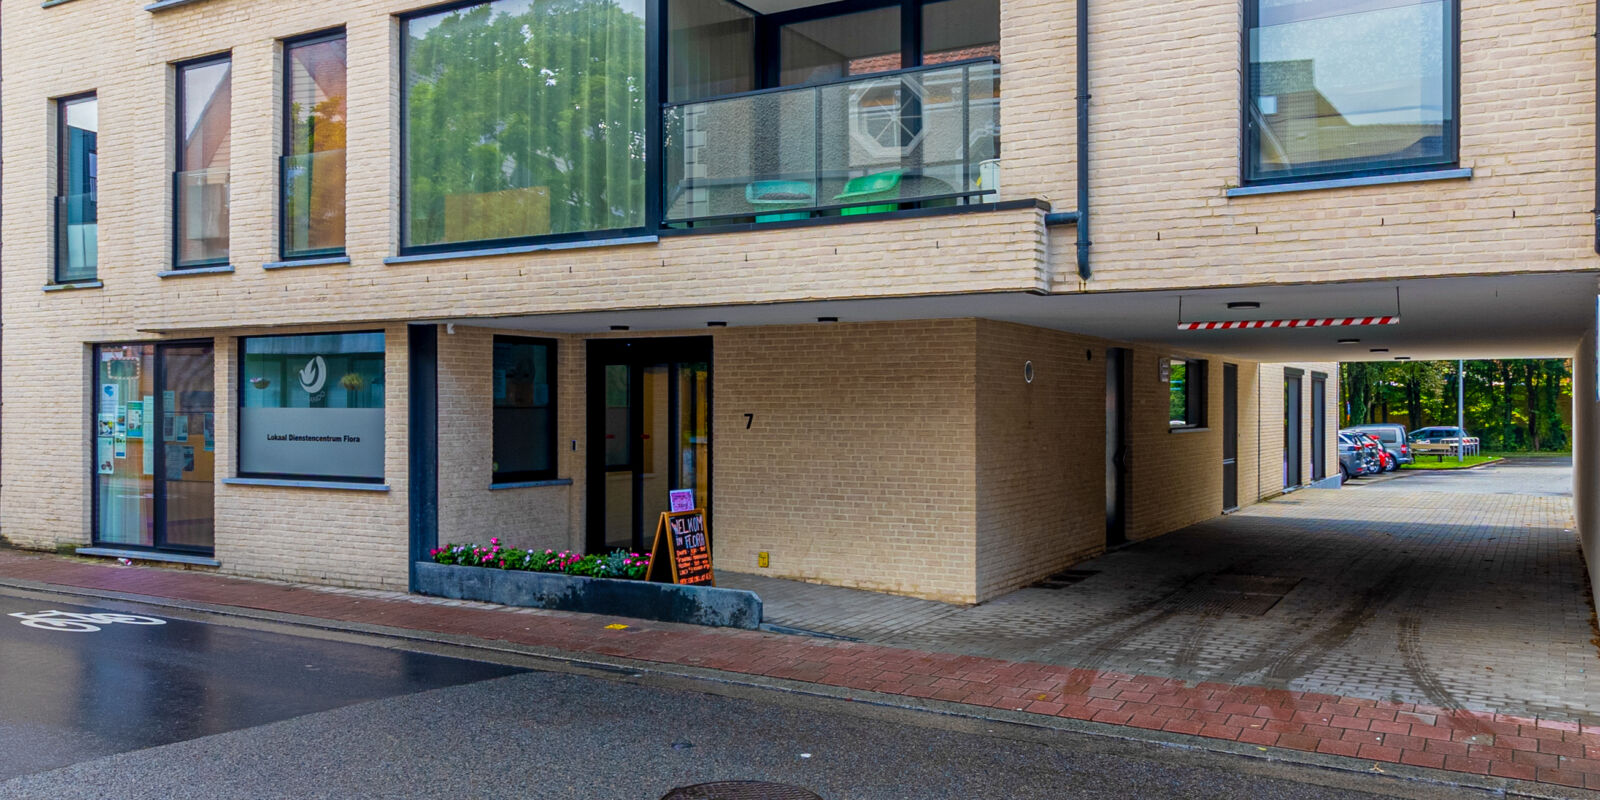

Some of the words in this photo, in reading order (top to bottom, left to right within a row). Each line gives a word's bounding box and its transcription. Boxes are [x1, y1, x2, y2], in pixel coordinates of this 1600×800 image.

[744, 414, 753, 429] 7
[267, 433, 287, 441] Lokaal
[288, 434, 342, 442] Dienstencentrum
[343, 435, 360, 443] Flora
[671, 516, 703, 534] WELKOM
[685, 533, 705, 549] FLORA
